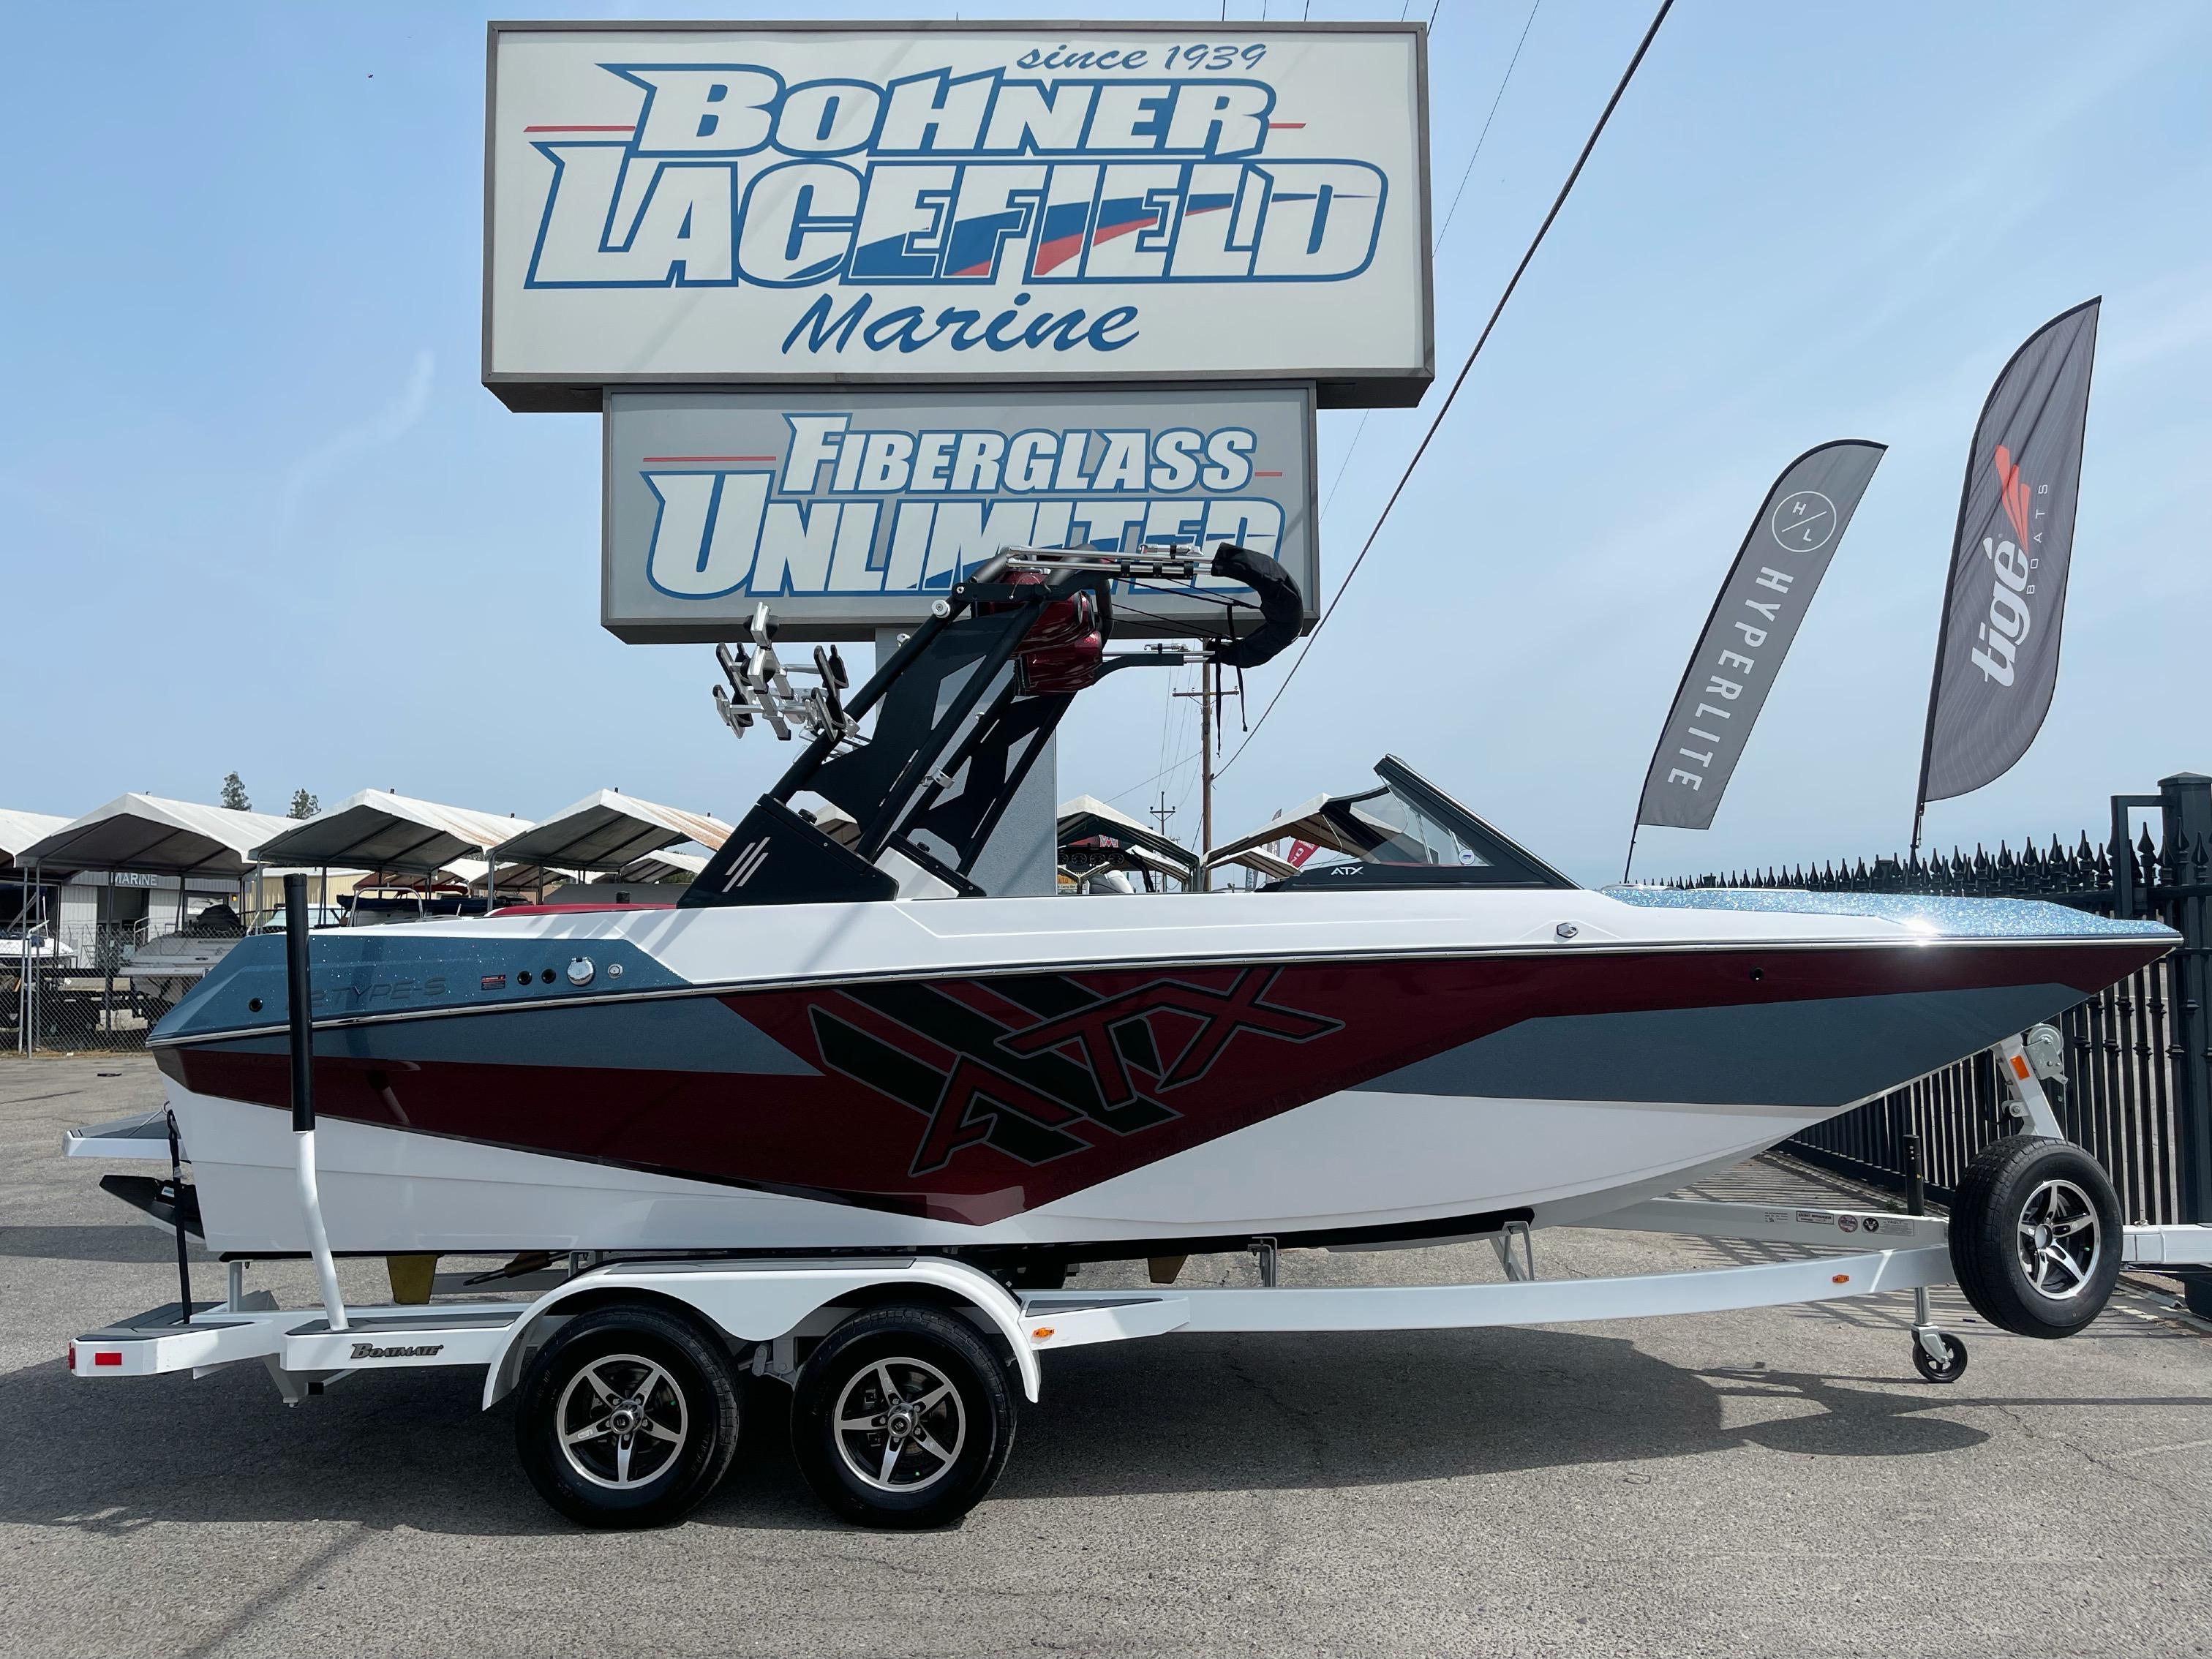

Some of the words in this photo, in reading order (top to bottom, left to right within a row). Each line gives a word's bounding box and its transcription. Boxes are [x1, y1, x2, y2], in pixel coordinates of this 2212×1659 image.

[1017, 43, 1149, 70] since
[1165, 43, 1268, 74] 1939
[596, 63, 1277, 159] BOHNER
[523, 140, 1389, 290] LACEFIELD
[781, 292, 1139, 356] Marine
[781, 413, 1257, 495] FIBERGLASS
[1792, 501, 1807, 516] H
[2025, 484, 2048, 595] BOATS
[1971, 536, 2031, 687] tigé
[1667, 565, 1794, 792] HYPERLITE
[111, 871, 157, 886] MARINE
[1331, 866, 1363, 876] ATX
[908, 966, 1346, 1177] ATX
[350, 1343, 440, 1359] BOATMATE
